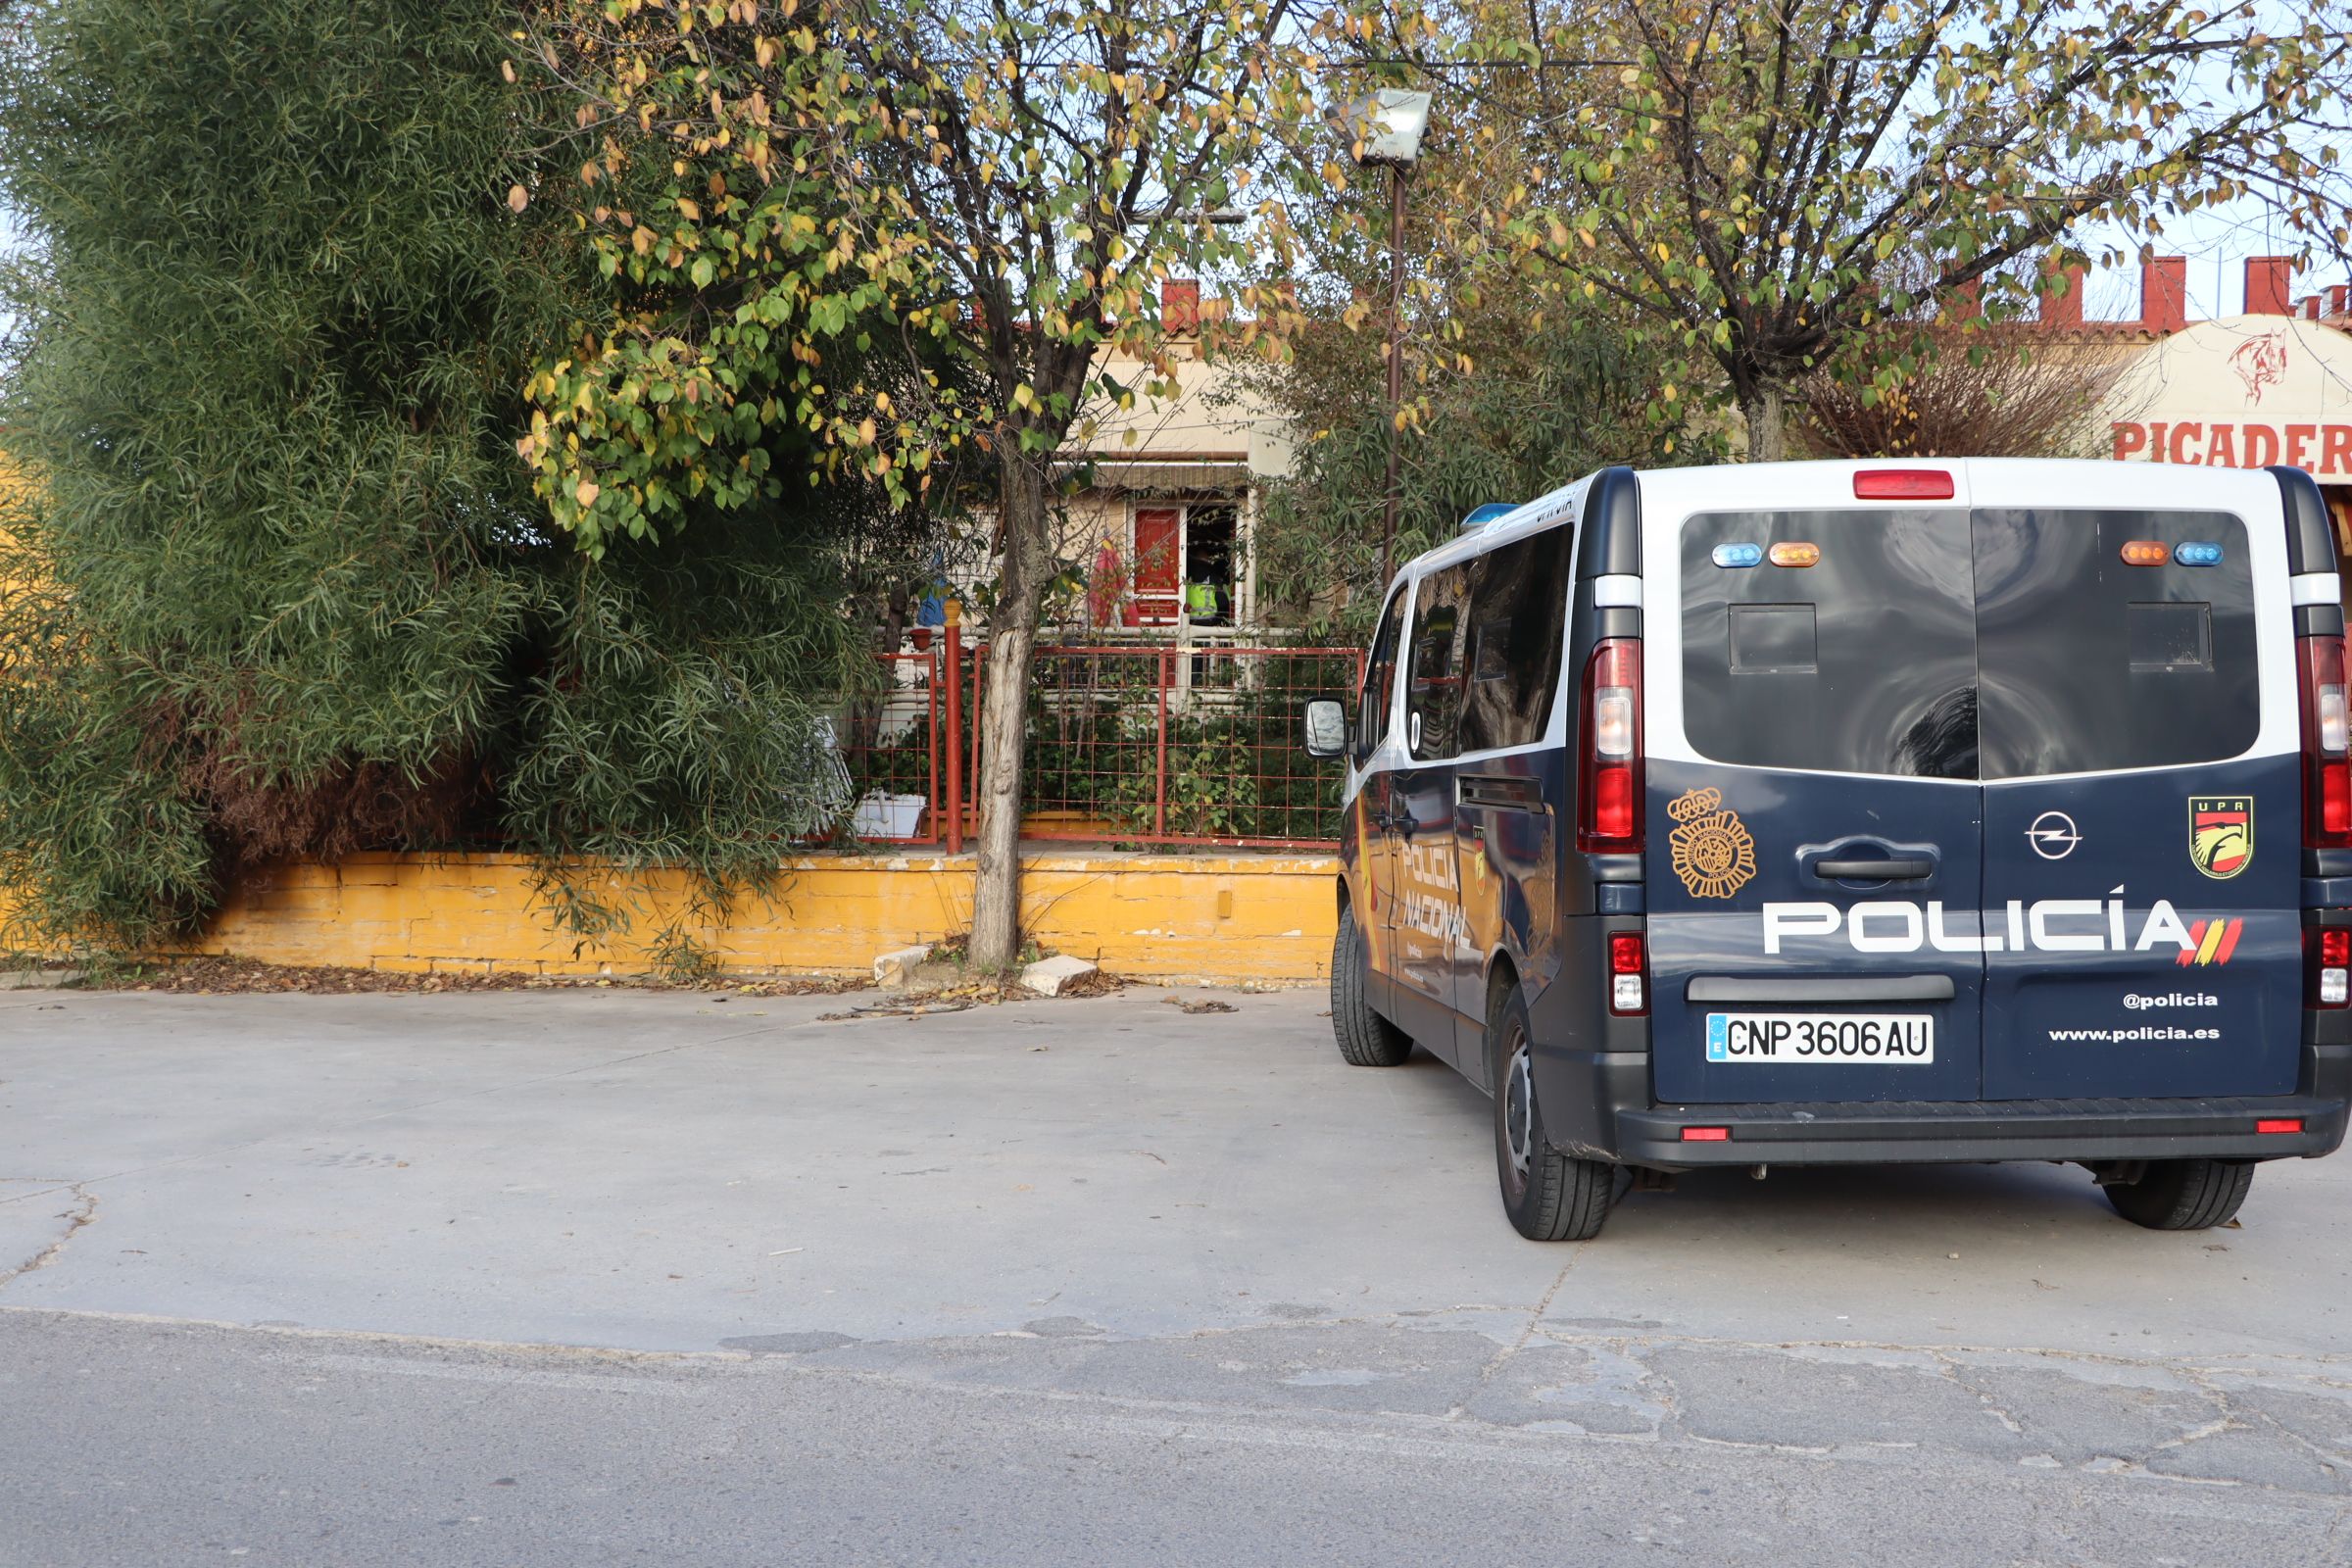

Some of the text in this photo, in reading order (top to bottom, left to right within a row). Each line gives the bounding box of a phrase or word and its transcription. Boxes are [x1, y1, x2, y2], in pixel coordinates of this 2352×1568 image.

[2111, 421, 2352, 474] PICADER
[2198, 802, 2243, 811] UPR
[1402, 889, 1470, 950] NACIONAL
[1762, 883, 2198, 955] POLICÍA
[2123, 993, 2219, 1010] @policia
[2049, 1027, 2221, 1044] www.policia.es
